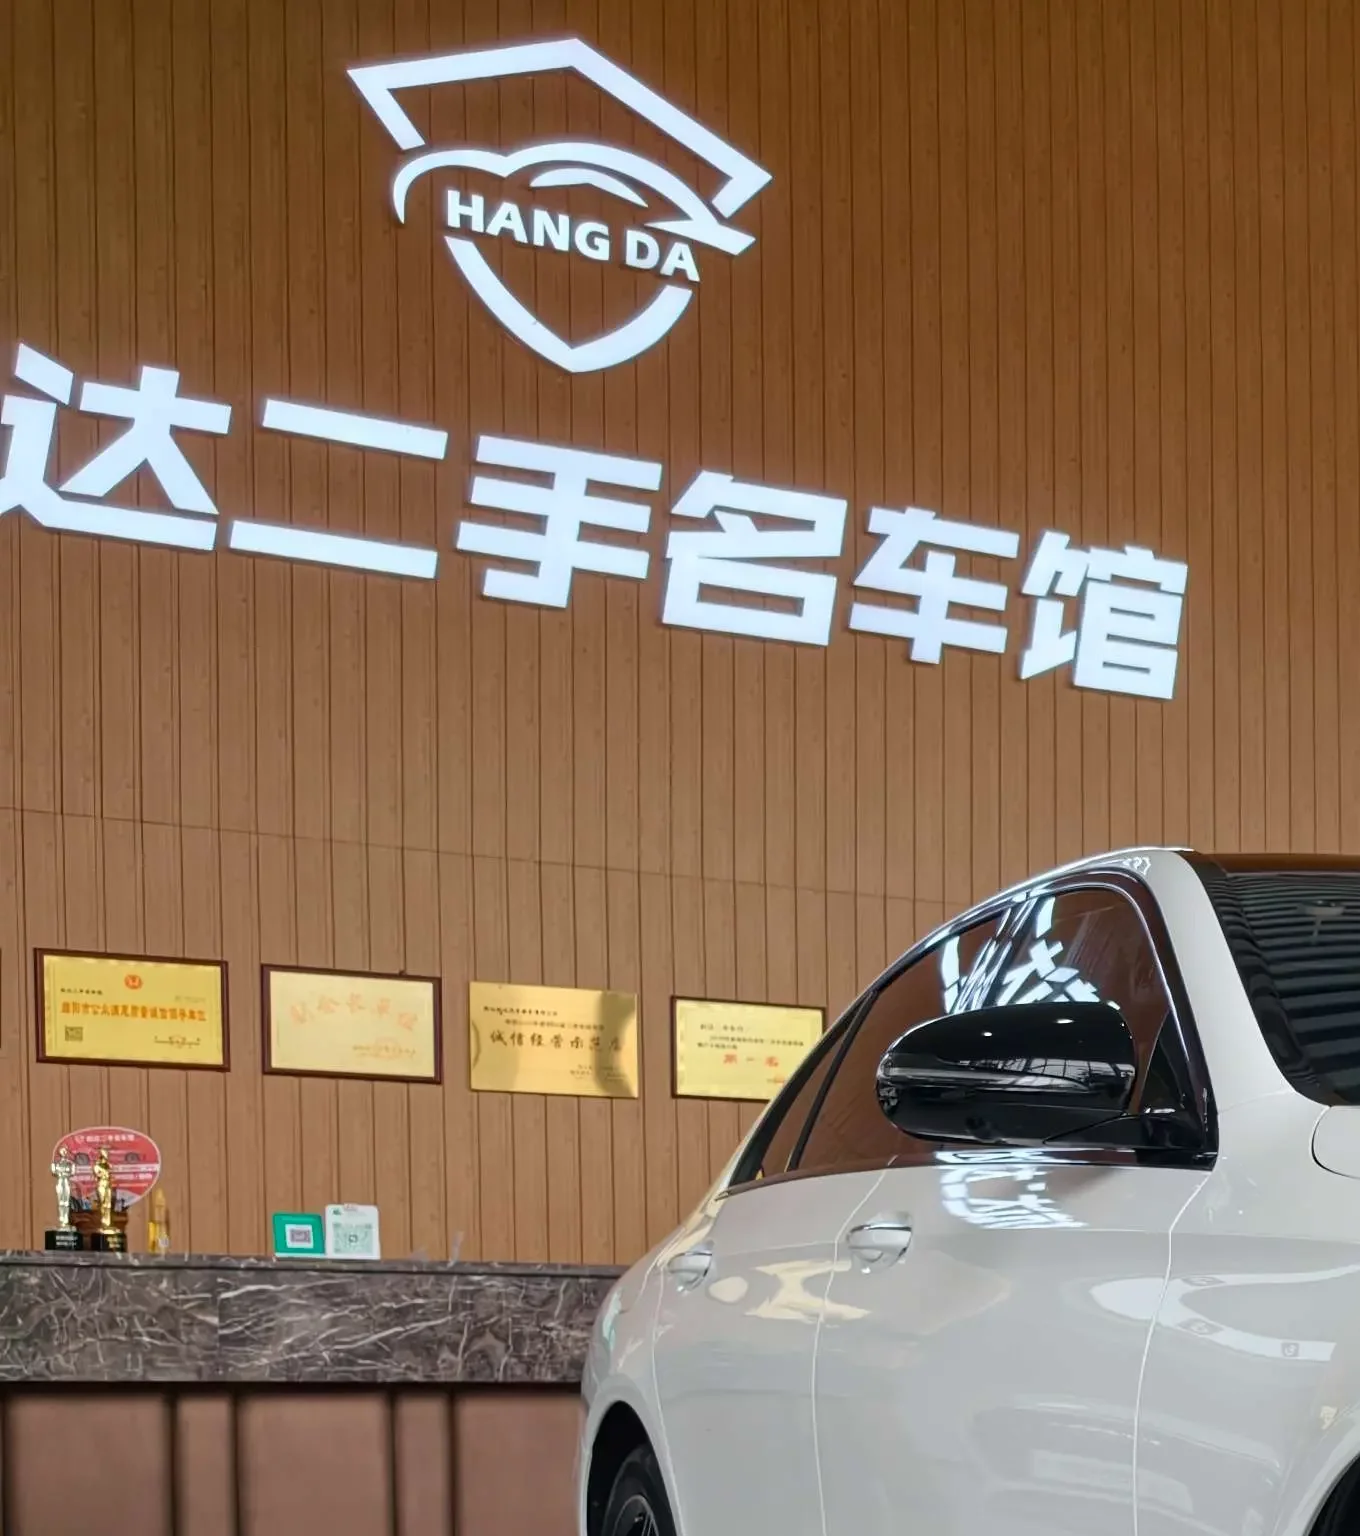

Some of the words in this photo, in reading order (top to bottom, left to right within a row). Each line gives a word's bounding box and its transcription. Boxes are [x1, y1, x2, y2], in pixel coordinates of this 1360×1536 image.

[447, 190, 610, 261] HANG
[625, 230, 700, 282] DA
[0, 343, 1188, 699] 达二手名车馆
